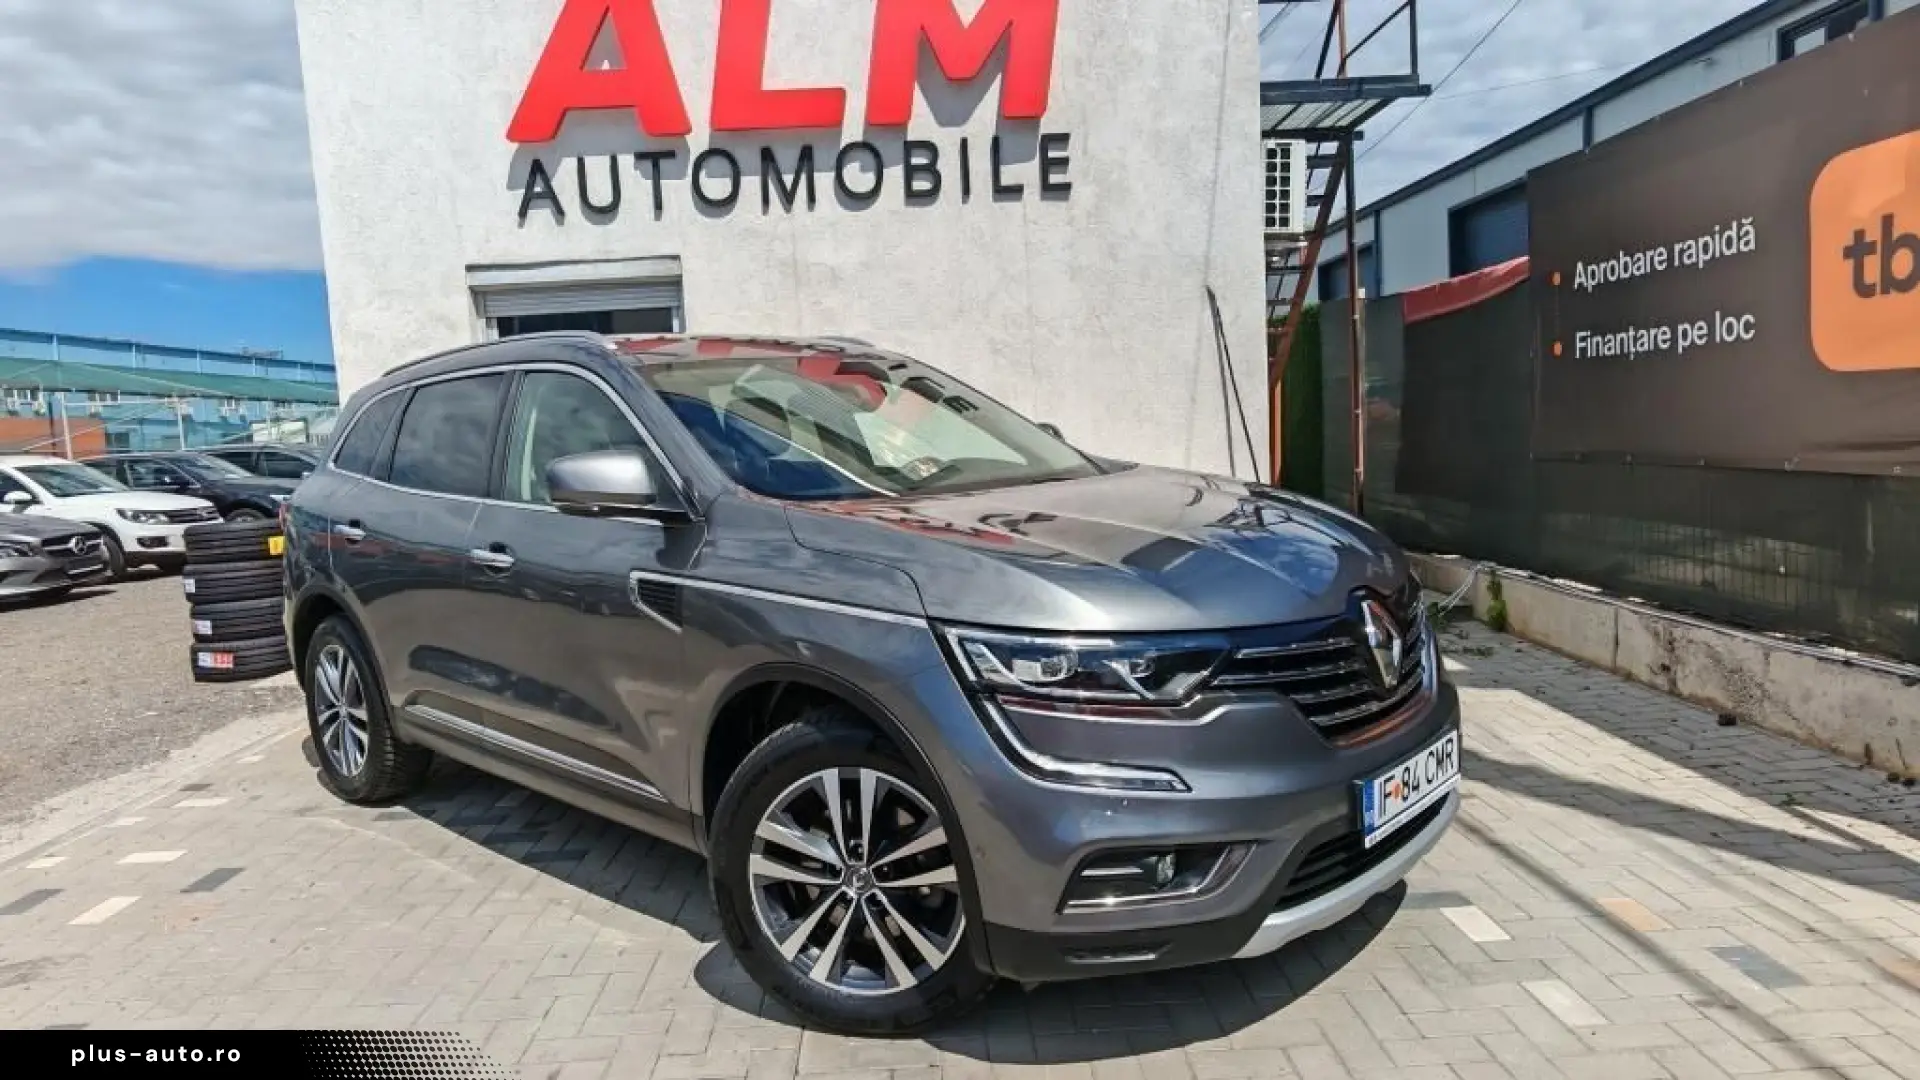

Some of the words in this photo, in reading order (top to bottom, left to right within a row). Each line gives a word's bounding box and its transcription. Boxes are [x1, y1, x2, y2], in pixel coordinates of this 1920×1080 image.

[506, 0, 1060, 142] ALM
[518, 132, 1073, 222] AUTOMOBILE
[1574, 246, 1668, 293] Aprobare
[1673, 216, 1756, 269] rapidă
[1574, 324, 1672, 361] Finanțare
[1677, 318, 1709, 354] pe
[1714, 310, 1756, 344] loc
[1380, 774, 1396, 818] IF
[1402, 760, 1420, 802] 84
[1425, 738, 1454, 784] CMR
